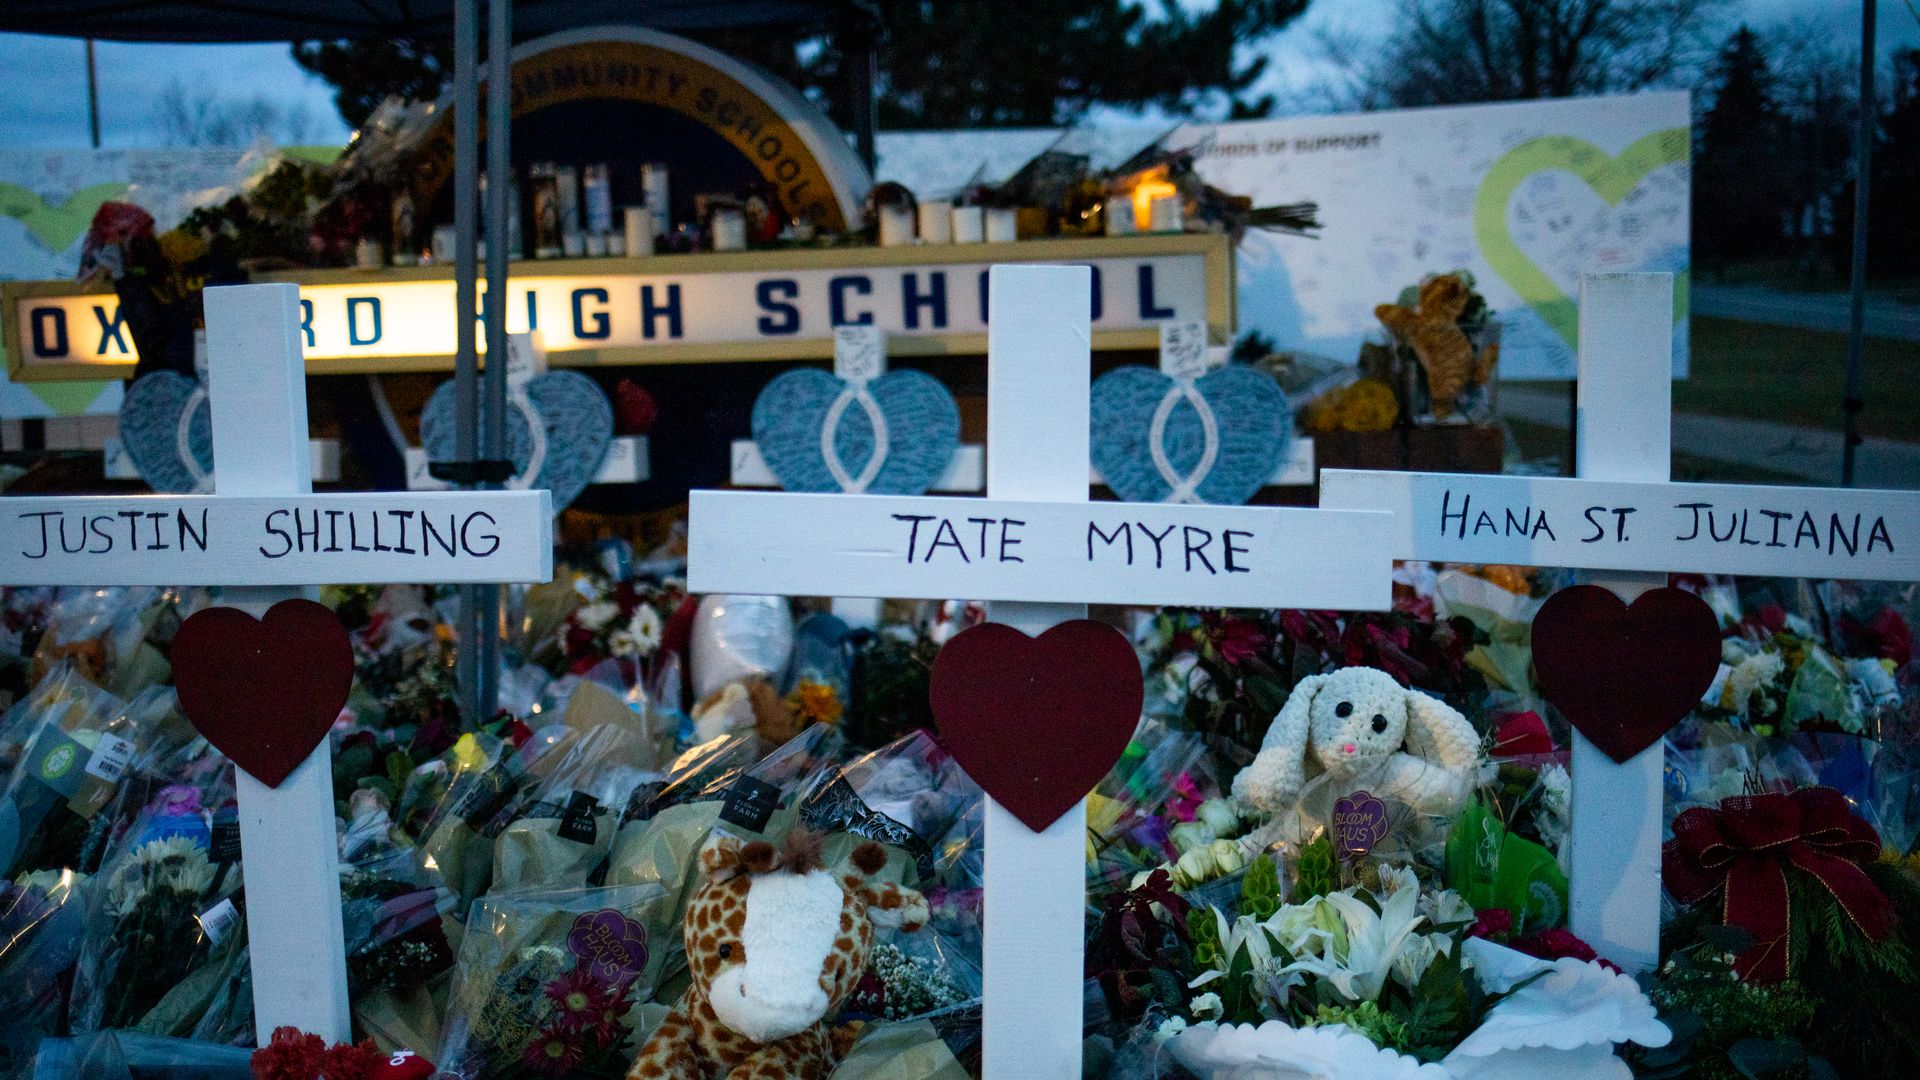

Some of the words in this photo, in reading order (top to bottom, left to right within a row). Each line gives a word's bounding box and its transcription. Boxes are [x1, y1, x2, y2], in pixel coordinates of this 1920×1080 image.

[475, 284, 685, 340] IGH
[755, 264, 1176, 336] SCHL
[18, 508, 208, 559] JUSTIN
[258, 507, 502, 559] SHILLING
[891, 514, 1026, 564] TATE
[1087, 521, 1255, 575] MYRE
[1440, 490, 1556, 542] HANA
[1580, 507, 1637, 543] ST.
[1674, 503, 1896, 557] JULIANA
[733, 805, 758, 821] FARM
[1334, 812, 1374, 826] BLOOM
[582, 933, 619, 977] HAUS
[595, 923, 634, 969] BLOOM
